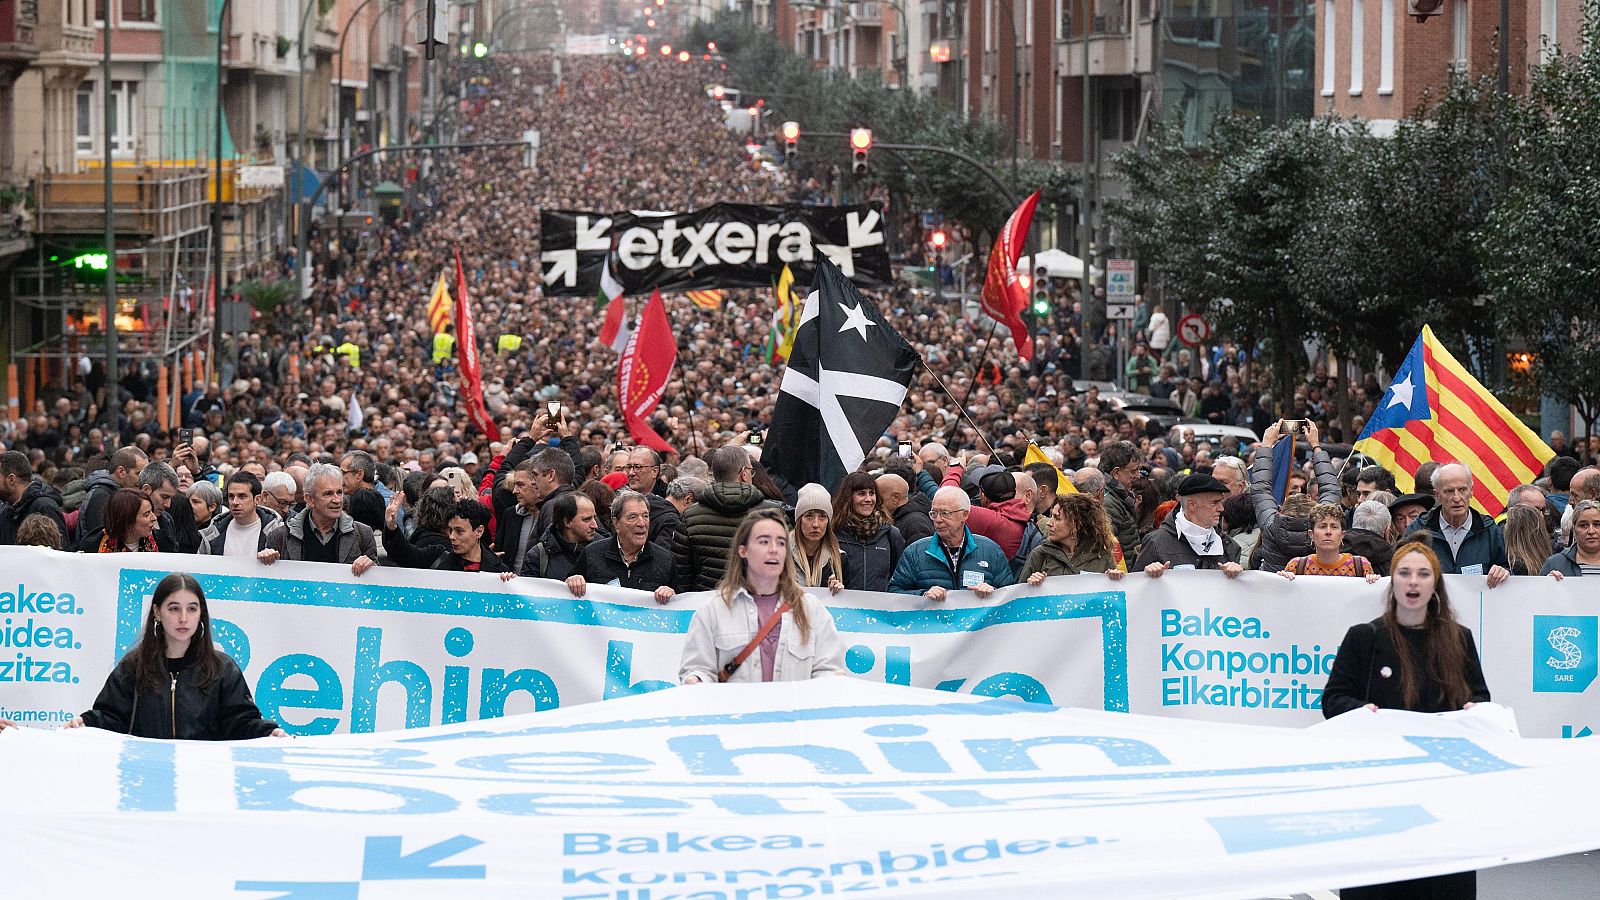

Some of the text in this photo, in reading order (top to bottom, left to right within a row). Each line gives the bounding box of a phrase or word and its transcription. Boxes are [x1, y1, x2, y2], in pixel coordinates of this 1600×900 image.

[618, 219, 815, 271] etxera
[1161, 608, 1271, 639] Bakea.
[1554, 674, 1574, 682] SARE
[230, 723, 1173, 777] Behin
[563, 832, 825, 856] Bakea.
